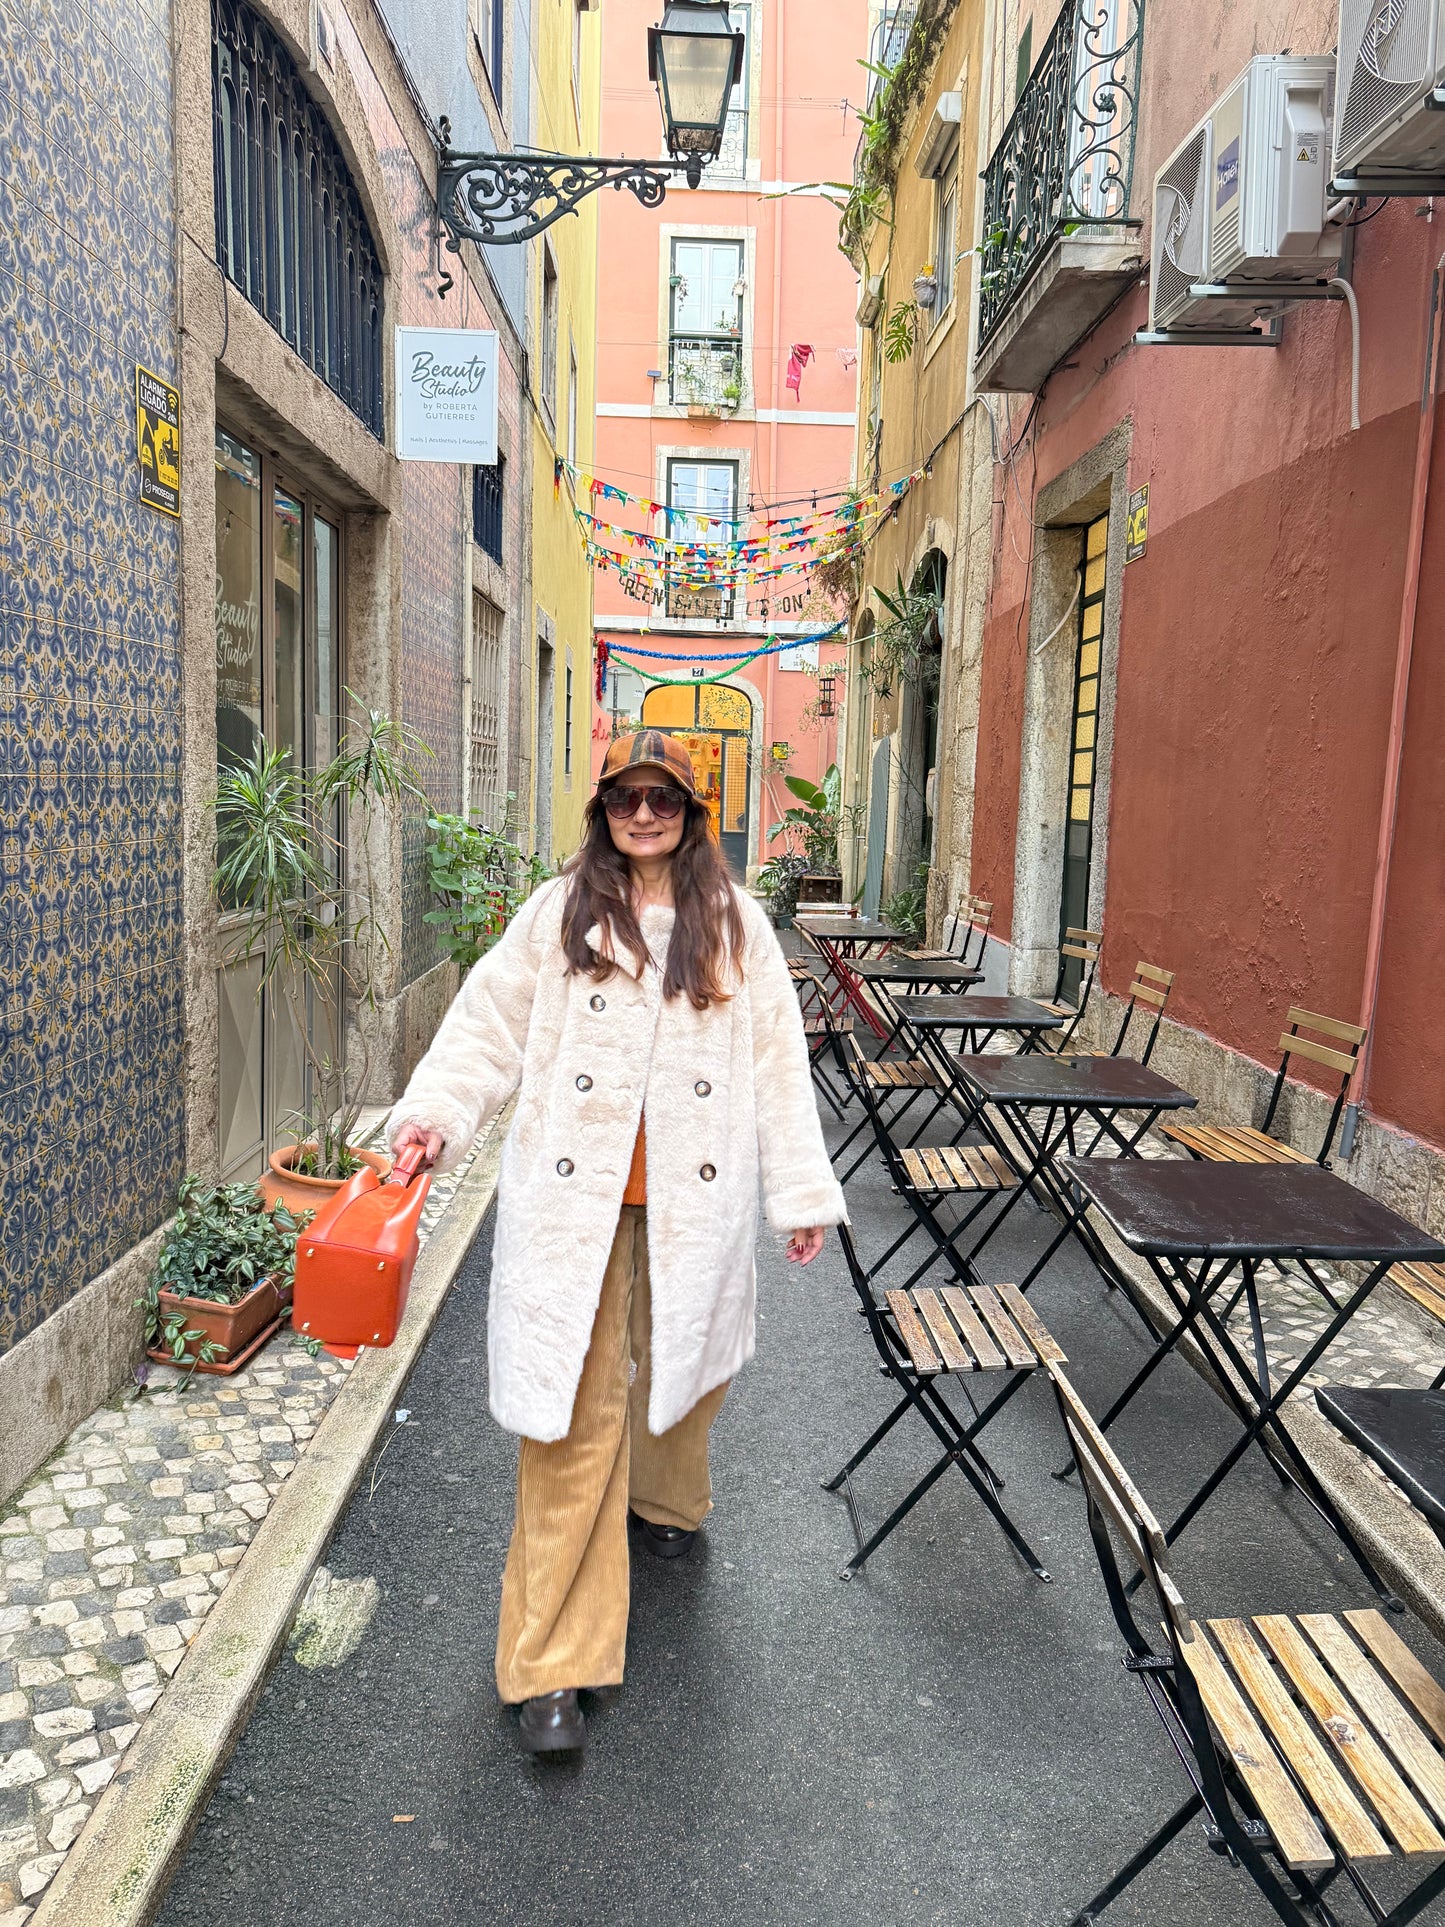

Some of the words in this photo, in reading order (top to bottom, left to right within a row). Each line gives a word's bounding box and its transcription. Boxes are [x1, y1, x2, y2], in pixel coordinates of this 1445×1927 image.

[412, 351, 486, 393] Beauty
[140, 373, 167, 401] ALARME
[420, 378, 469, 399] Studio
[140, 386, 167, 414] LIGADO
[423, 402, 433, 410] by
[436, 402, 478, 411] ROBERTA
[425, 412, 476, 421] GUTIERRES
[215, 627, 250, 670] Studio
[692, 667, 705, 677] 27
